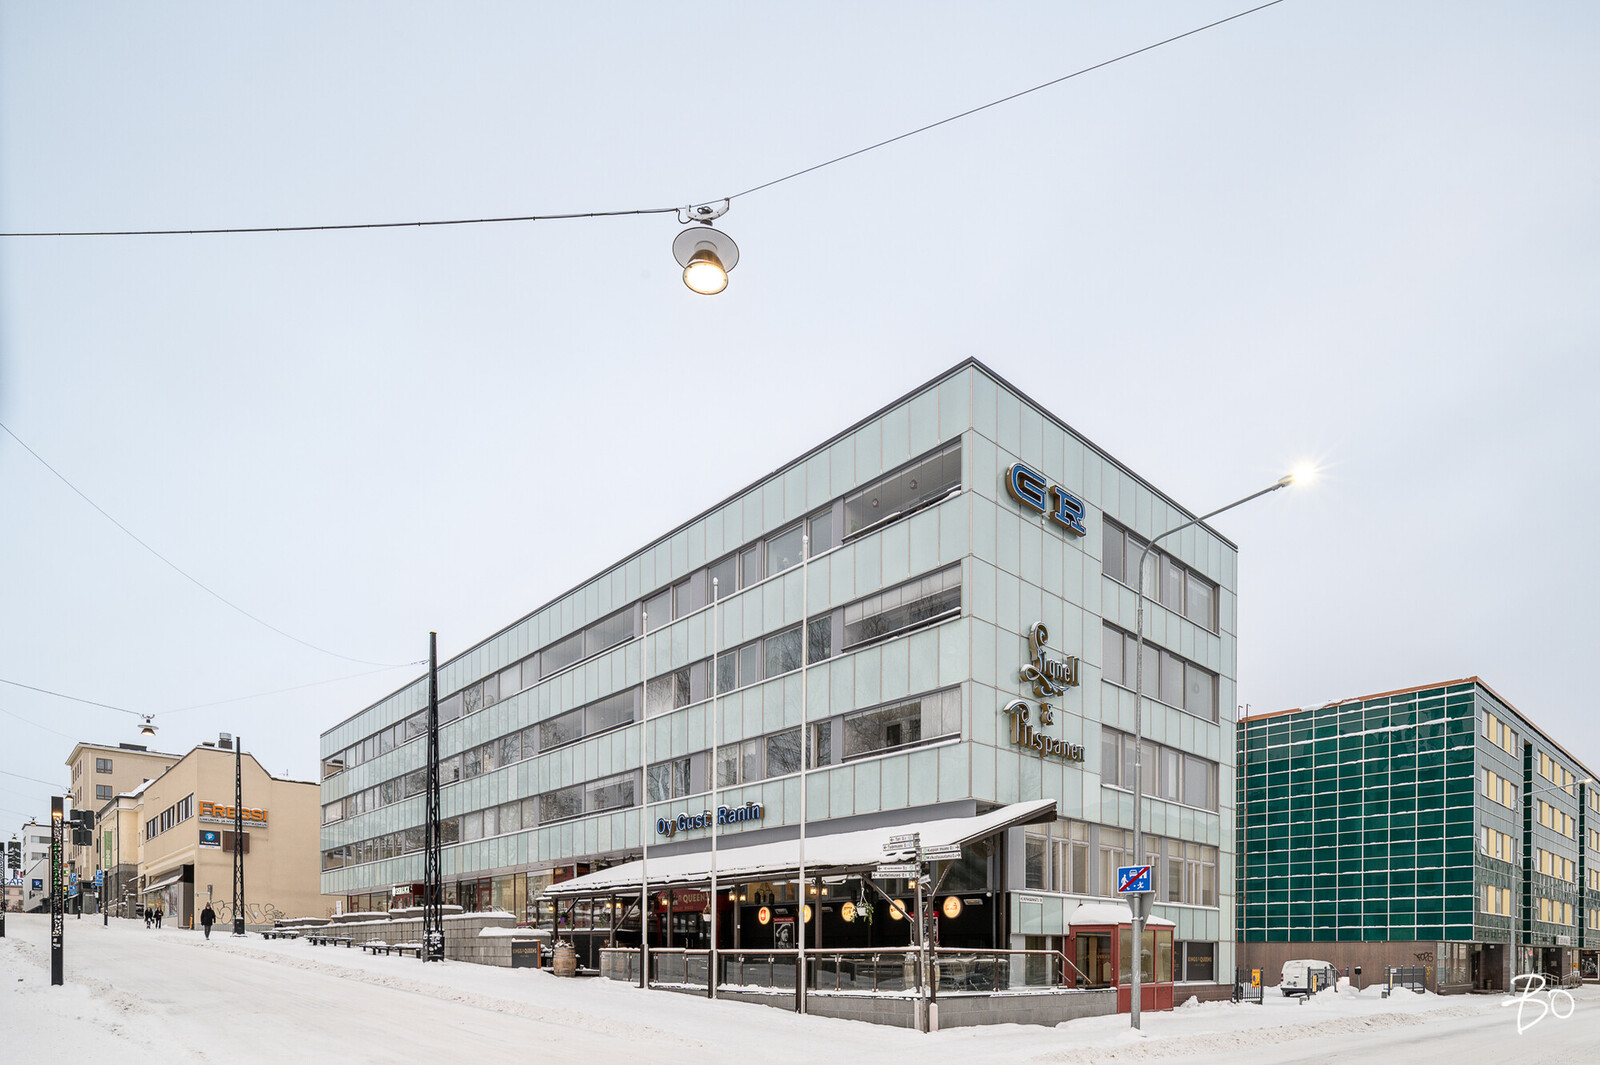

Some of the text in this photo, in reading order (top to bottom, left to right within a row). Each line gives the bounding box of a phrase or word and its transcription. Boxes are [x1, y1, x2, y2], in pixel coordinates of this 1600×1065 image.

[1005, 462, 1086, 537] GR
[1003, 699, 1085, 762] Piispanen
[1040, 702, 1054, 725] &
[199, 800, 268, 822] FRESSI
[656, 817, 676, 838] Oy
[717, 802, 764, 826] Ranin
